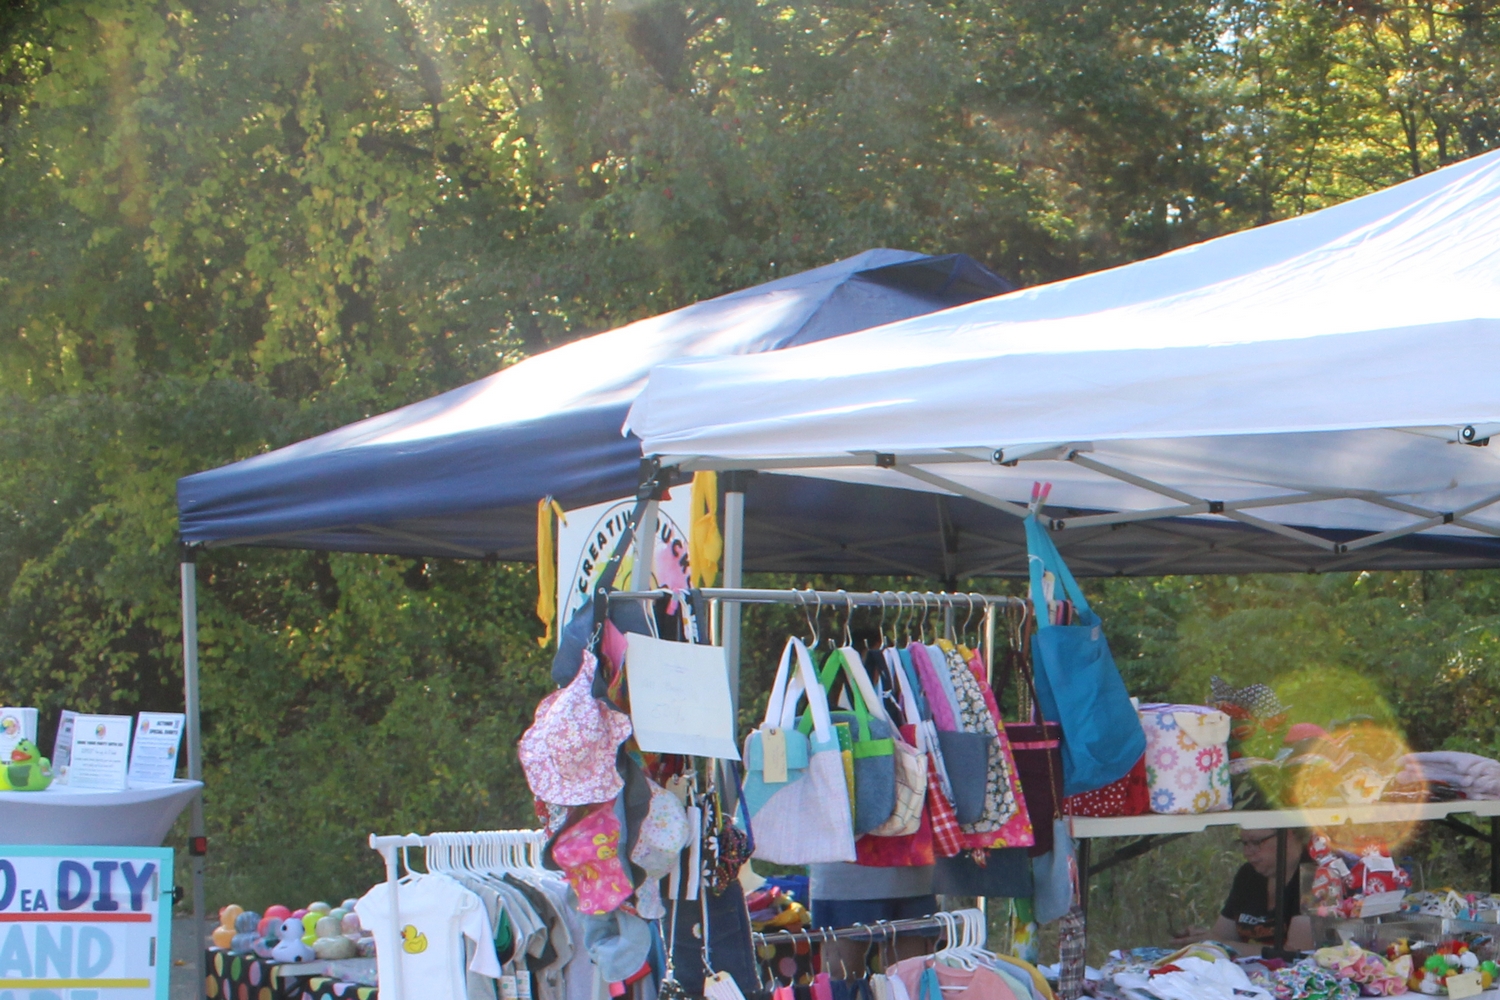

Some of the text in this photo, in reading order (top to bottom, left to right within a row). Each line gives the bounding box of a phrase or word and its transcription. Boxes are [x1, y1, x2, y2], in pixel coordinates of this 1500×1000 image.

[20, 889, 49, 911] EA
[57, 860, 156, 912] DIY
[0, 924, 115, 979] AND
